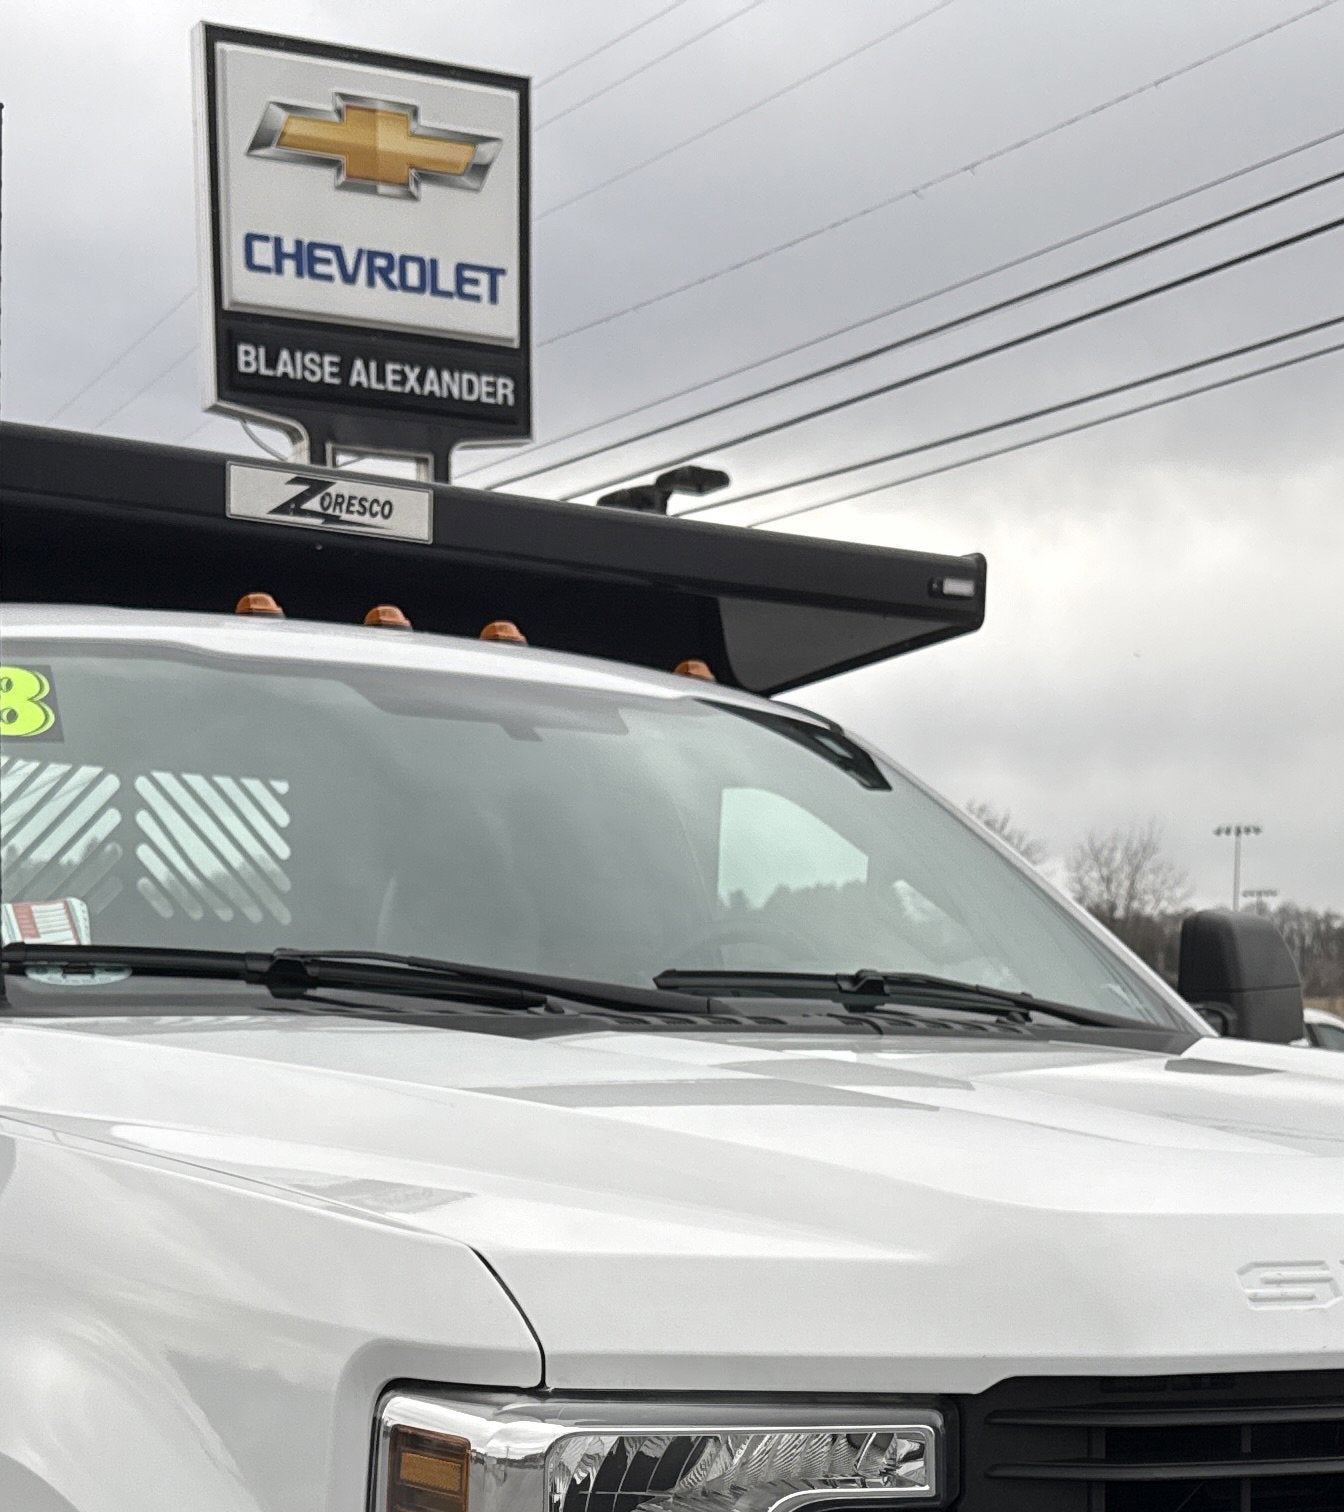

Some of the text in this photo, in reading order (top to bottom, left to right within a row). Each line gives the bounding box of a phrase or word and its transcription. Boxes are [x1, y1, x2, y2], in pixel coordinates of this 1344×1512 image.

[243, 232, 506, 305] CHEVROLET
[237, 342, 515, 406] BLAISE ALEXANDER
[266, 476, 394, 530] ZORESCO
